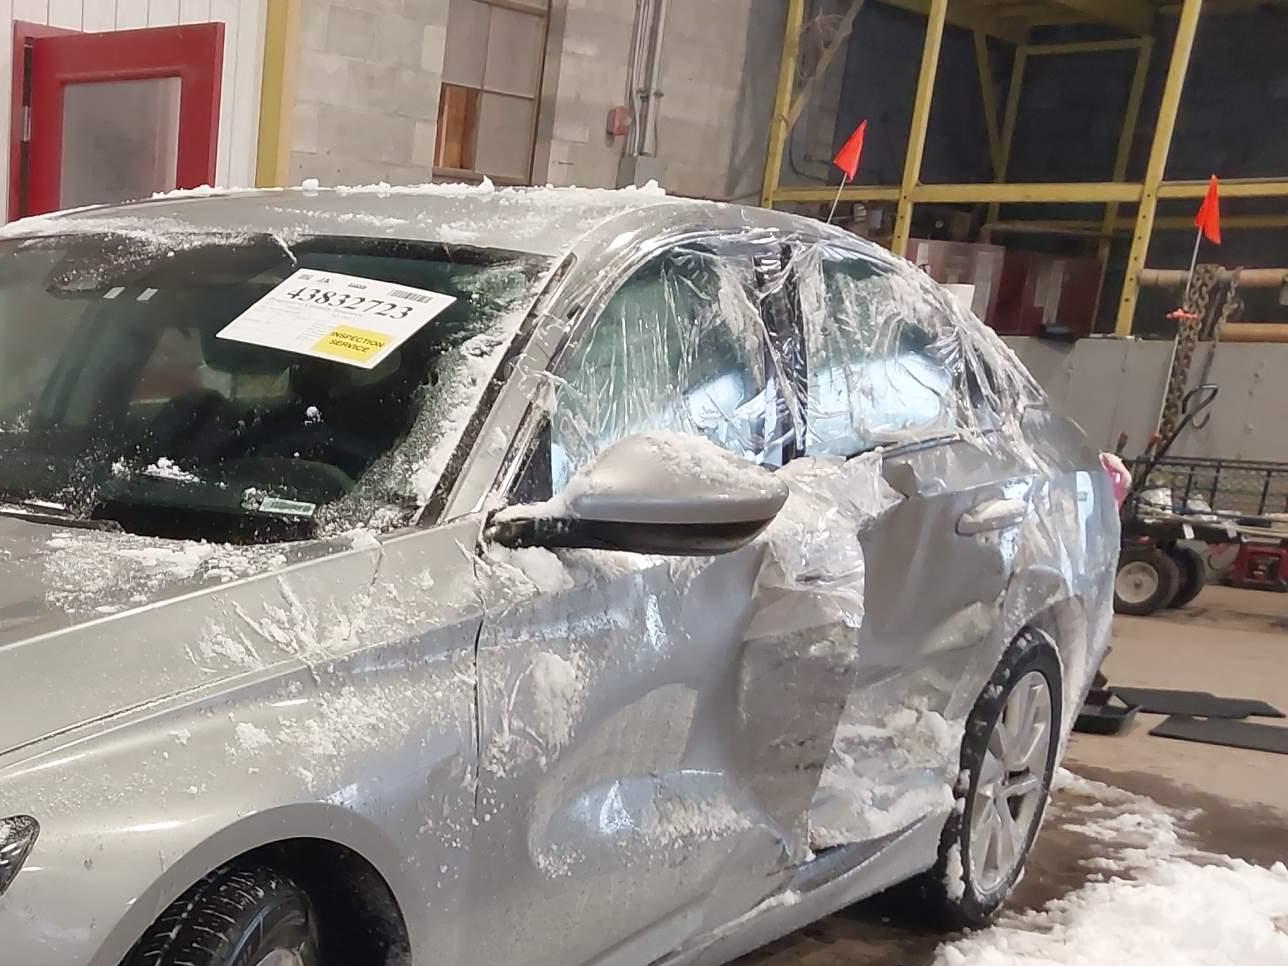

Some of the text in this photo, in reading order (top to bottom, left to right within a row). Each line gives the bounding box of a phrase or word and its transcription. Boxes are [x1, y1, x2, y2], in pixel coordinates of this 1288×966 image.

[287, 286, 413, 319] 43832723
[327, 339, 371, 354] SERVICE
[330, 331, 385, 348] INSPECTION
